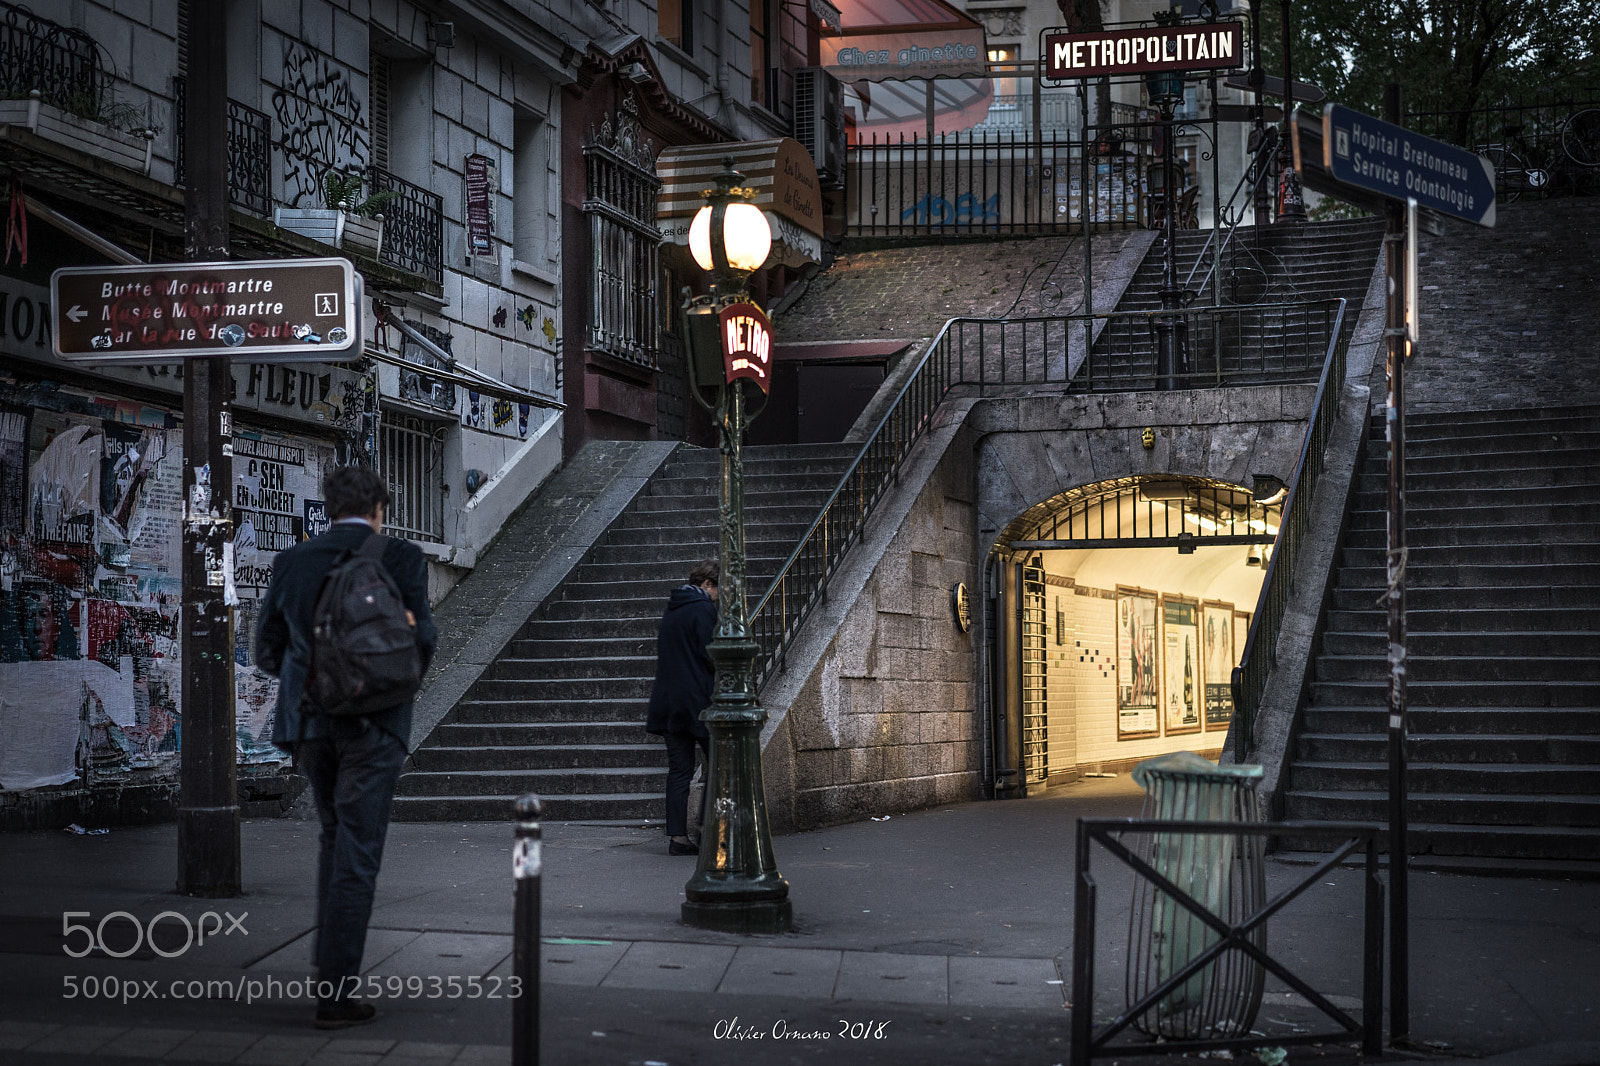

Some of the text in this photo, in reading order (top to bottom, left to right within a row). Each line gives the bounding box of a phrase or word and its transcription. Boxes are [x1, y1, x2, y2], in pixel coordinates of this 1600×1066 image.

[837, 43, 978, 68] Chez ginette
[1054, 31, 1233, 69] METROPOLITAIN
[1352, 123, 1468, 183] Hopital Bretonneau
[1353, 152, 1474, 212] Service Odontologie
[101, 280, 274, 299] Butte Montmartre
[102, 300, 284, 321] Musée Montmartre
[726, 315, 770, 364] METRO
[256, 442, 278, 459] ALBUM
[280, 446, 300, 464] DISPO
[237, 485, 249, 506] EN
[264, 514, 276, 532] 03
[277, 516, 293, 534] MAI
